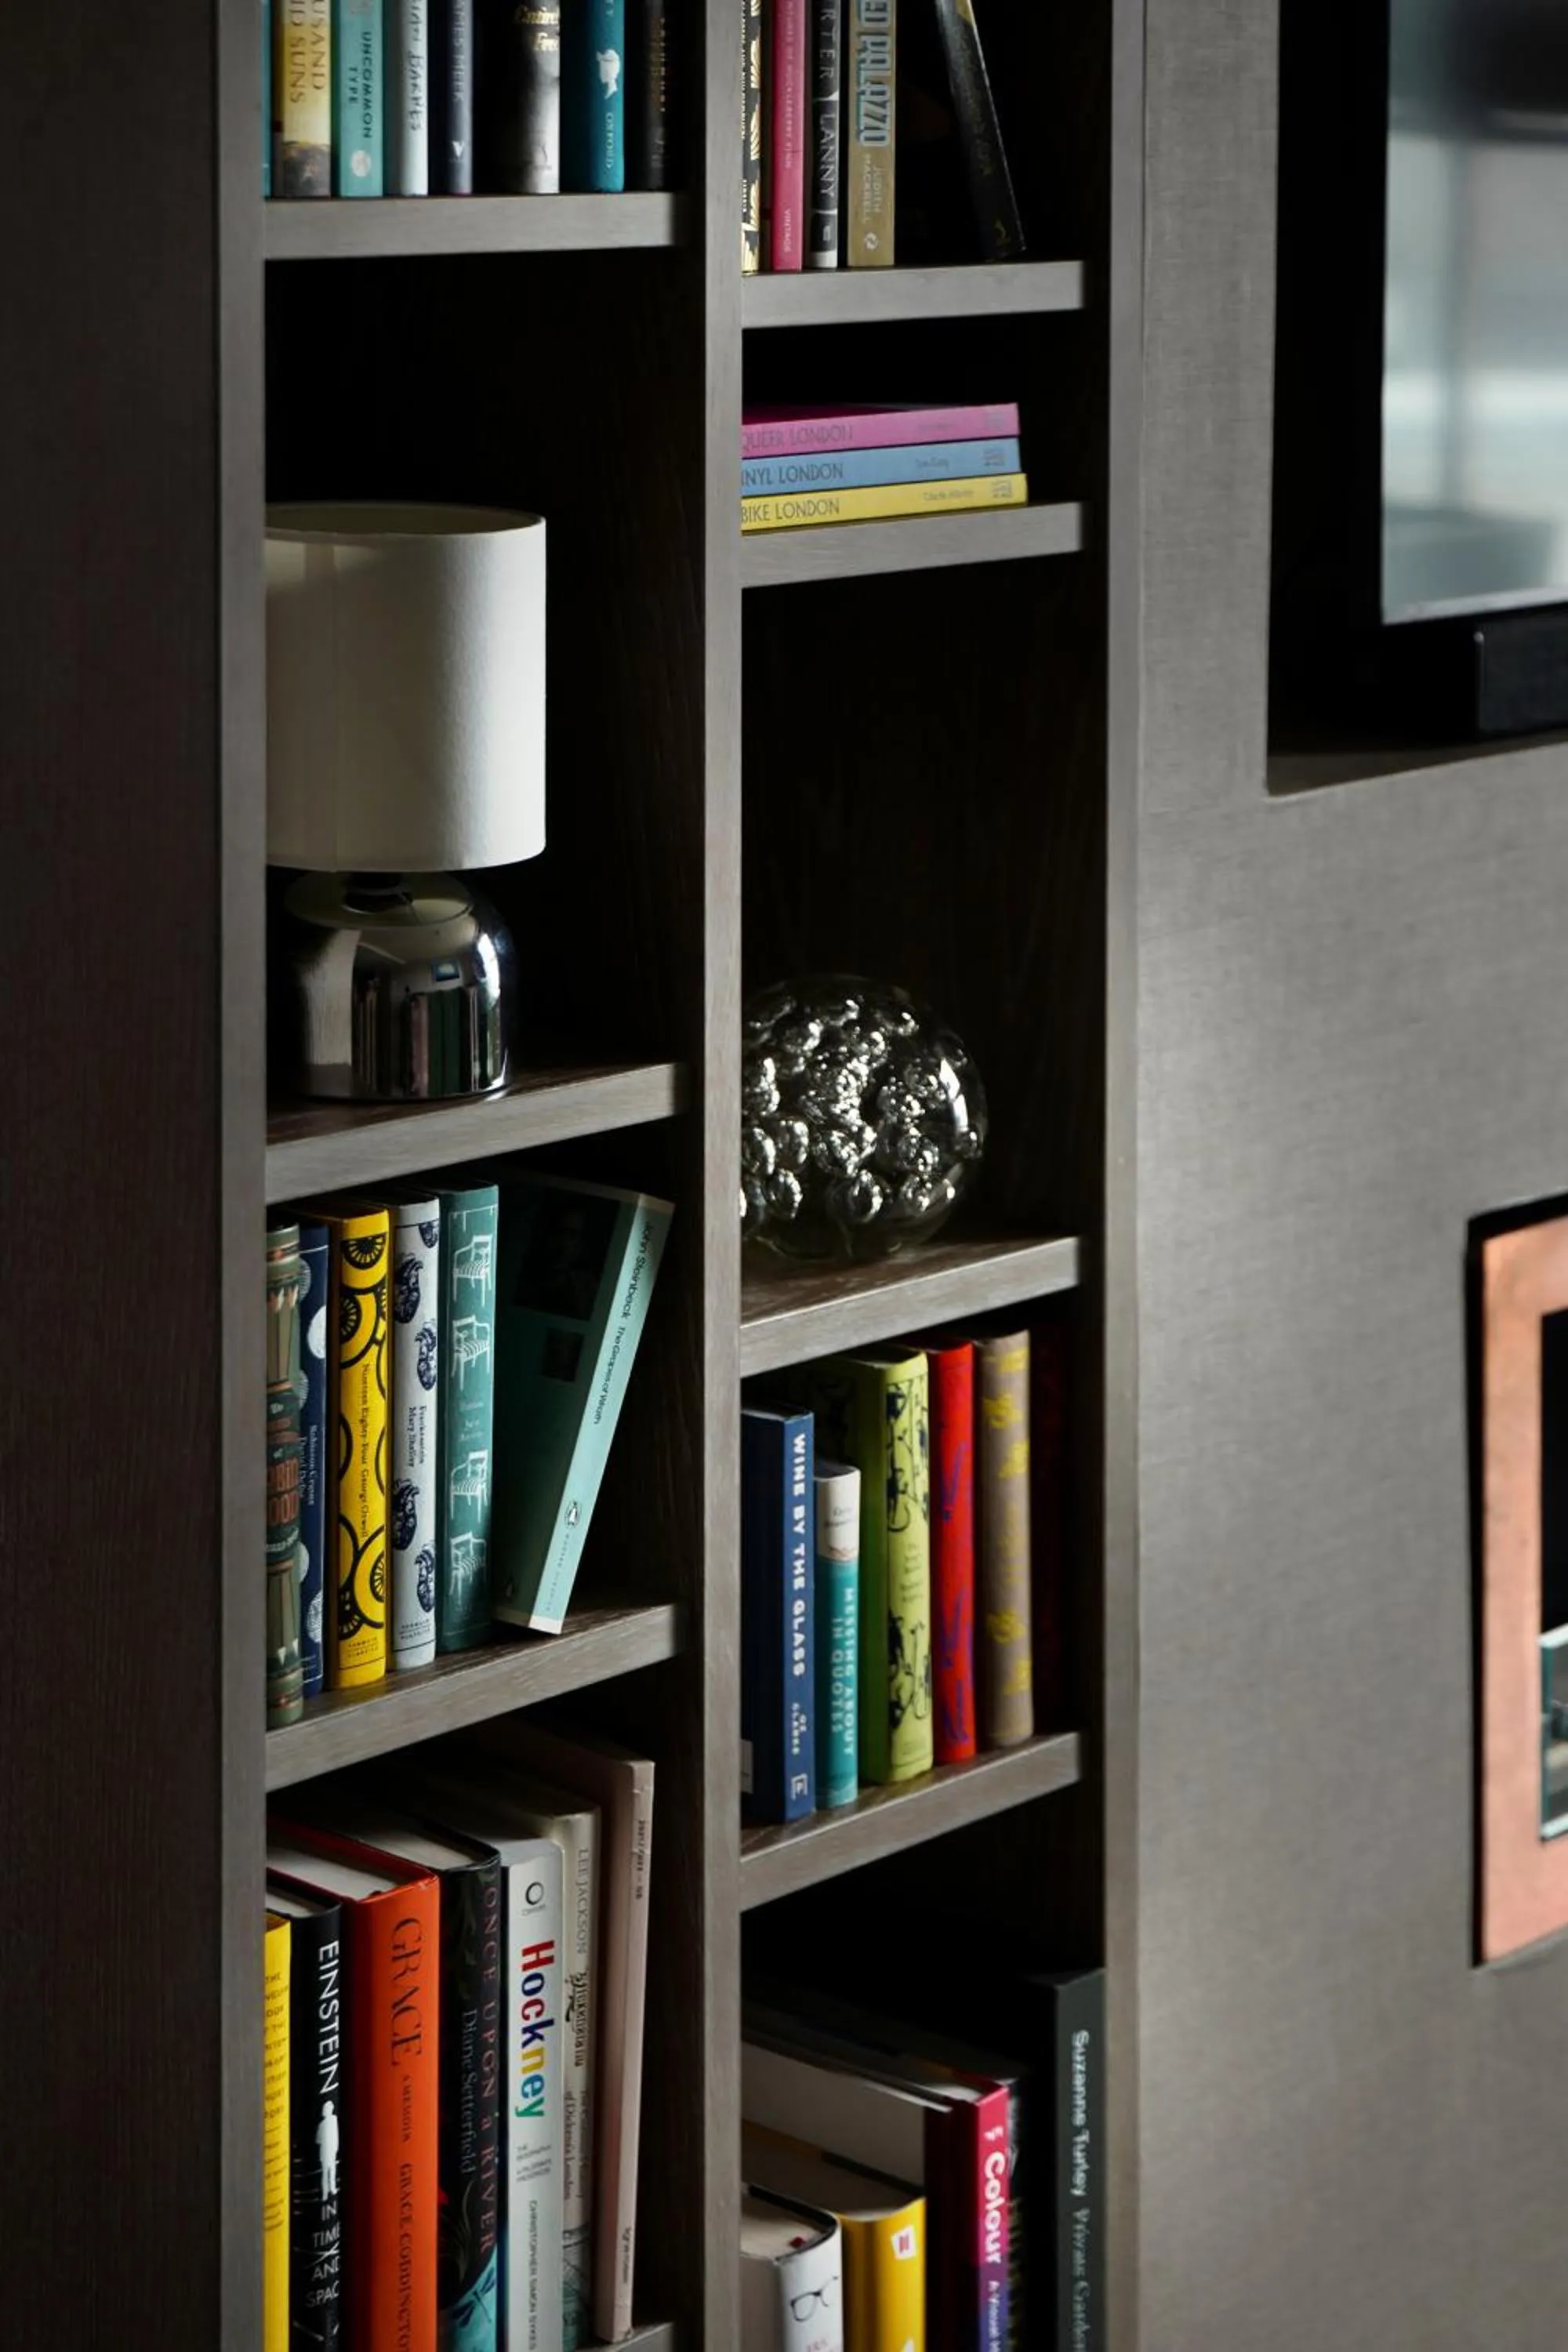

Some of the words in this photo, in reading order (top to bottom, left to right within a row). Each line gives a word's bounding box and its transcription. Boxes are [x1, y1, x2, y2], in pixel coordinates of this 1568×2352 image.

[290, 36, 307, 103] SUNS
[348, 67, 358, 104] TYPE
[362, 31, 373, 139] UNCOMMON
[857, 34, 891, 147] PALAZZO
[604, 112, 615, 169] OXFORD
[819, 114, 836, 198] LANNY
[873, 165, 884, 213] JUDITH
[783, 208, 792, 252] VINTAGE
[790, 425, 853, 446] LONDON
[779, 463, 844, 484] LONDON
[775, 498, 840, 520] LONDON
[639, 1221, 654, 1254] John
[622, 1255, 647, 1319] Steinbeck
[615, 1326, 626, 1345] The
[408, 1406, 417, 1431] Mary
[408, 1434, 417, 1467] Shelley
[793, 1433, 806, 1497] WINE
[793, 1505, 806, 1534] BY
[793, 1543, 806, 1590] THE
[793, 1599, 806, 1677] GLASS
[832, 1617, 843, 1638] IN
[844, 1588, 855, 1675] MESSING
[830, 1650, 844, 1733] QUOTES
[843, 1687, 855, 1756] ABOUT
[577, 1848, 590, 1876] LEE
[482, 1886, 499, 1983] ONCE
[575, 1879, 590, 1955] JACKSON
[319, 1940, 339, 2094] EINSTEIN
[391, 1917, 424, 2066] GRACE
[462, 2009, 478, 2070] Diane
[481, 2000, 499, 2100] UPON
[514, 1940, 556, 2119] Hockney
[1071, 2030, 1091, 2127] Suzanne
[461, 2071, 477, 2174] Setterfield
[398, 2163, 413, 2225] GRACE
[1069, 2129, 1091, 2196] Turley
[321, 2200, 337, 2221] IN
[481, 2145, 496, 2254] RIVER
[984, 2151, 1006, 2263] Colour
[1071, 2207, 1091, 2277] Private
